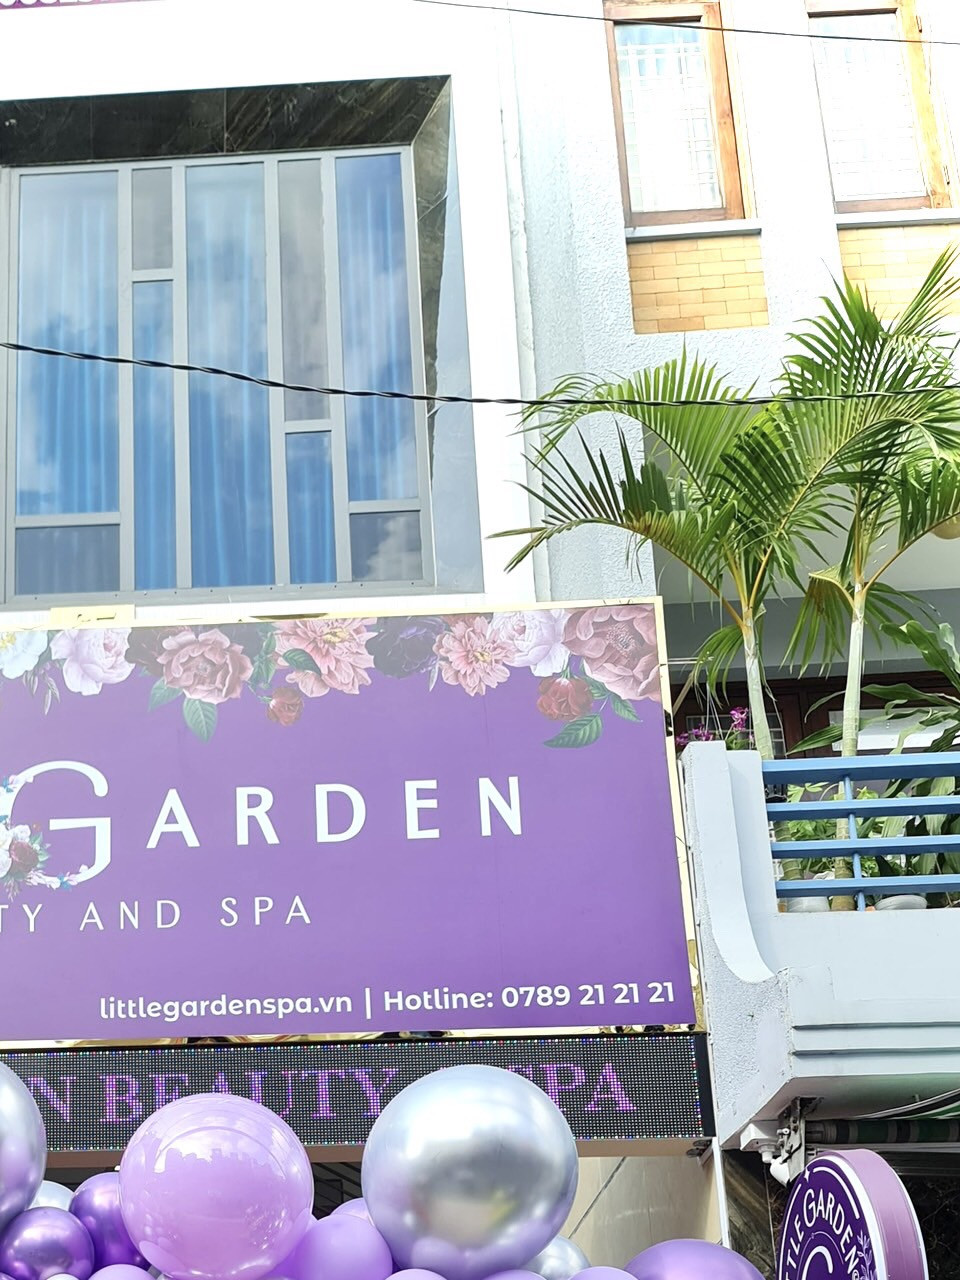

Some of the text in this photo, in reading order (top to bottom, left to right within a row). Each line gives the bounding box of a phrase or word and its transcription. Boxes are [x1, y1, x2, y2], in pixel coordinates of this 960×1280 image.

[79, 899, 181, 932] AND
[220, 895, 312, 927] SPA
[100, 994, 352, 1024] littlegardenspa.vn
[384, 987, 494, 1013] Hotline:
[501, 985, 571, 1008] 0789
[578, 983, 606, 1006] 21
[613, 982, 641, 1005] 21
[648, 981, 675, 1004] 21
[506, 1062, 637, 1112] PA
[803, 1188, 860, 1274] GARDEN
